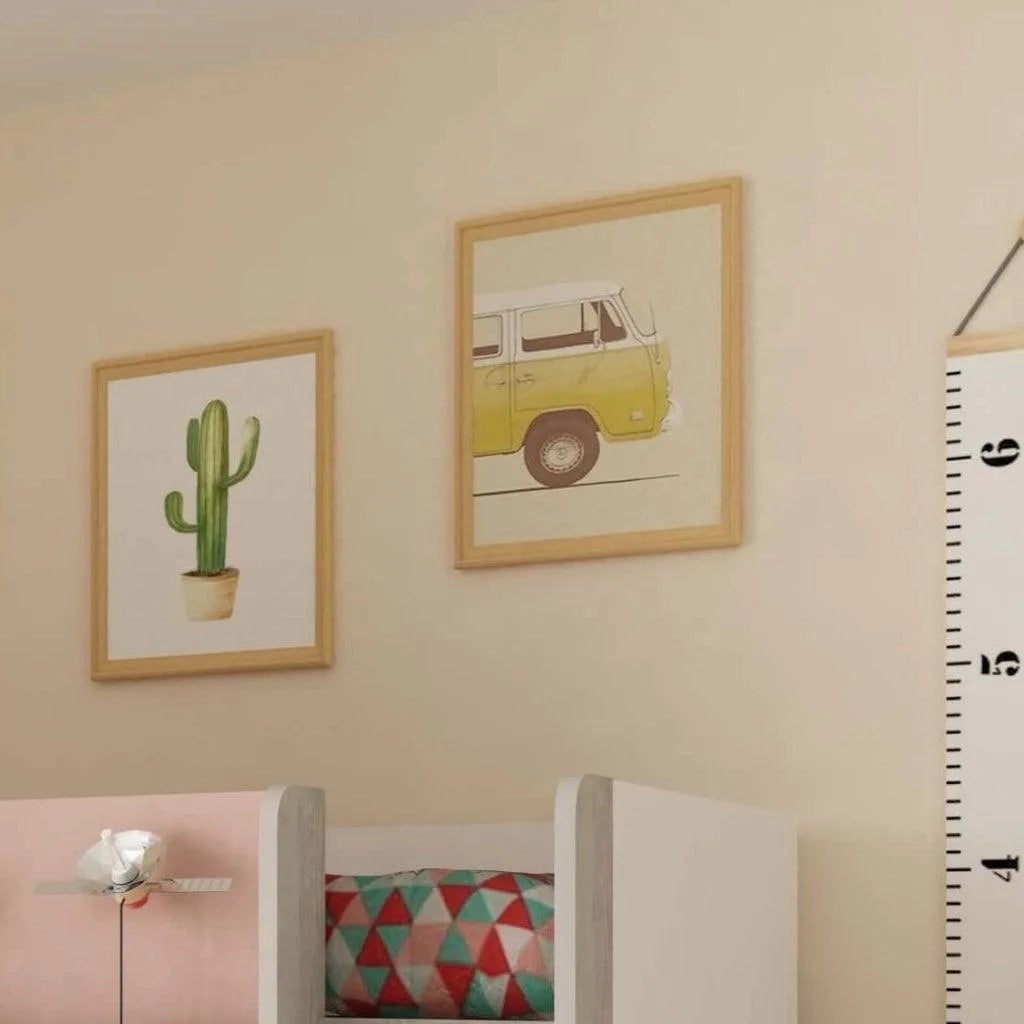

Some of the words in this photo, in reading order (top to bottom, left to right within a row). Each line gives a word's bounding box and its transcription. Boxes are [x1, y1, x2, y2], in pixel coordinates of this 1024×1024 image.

[980, 438, 1020, 467] 6
[980, 650, 1020, 677] 5
[980, 854, 1020, 882] 4
